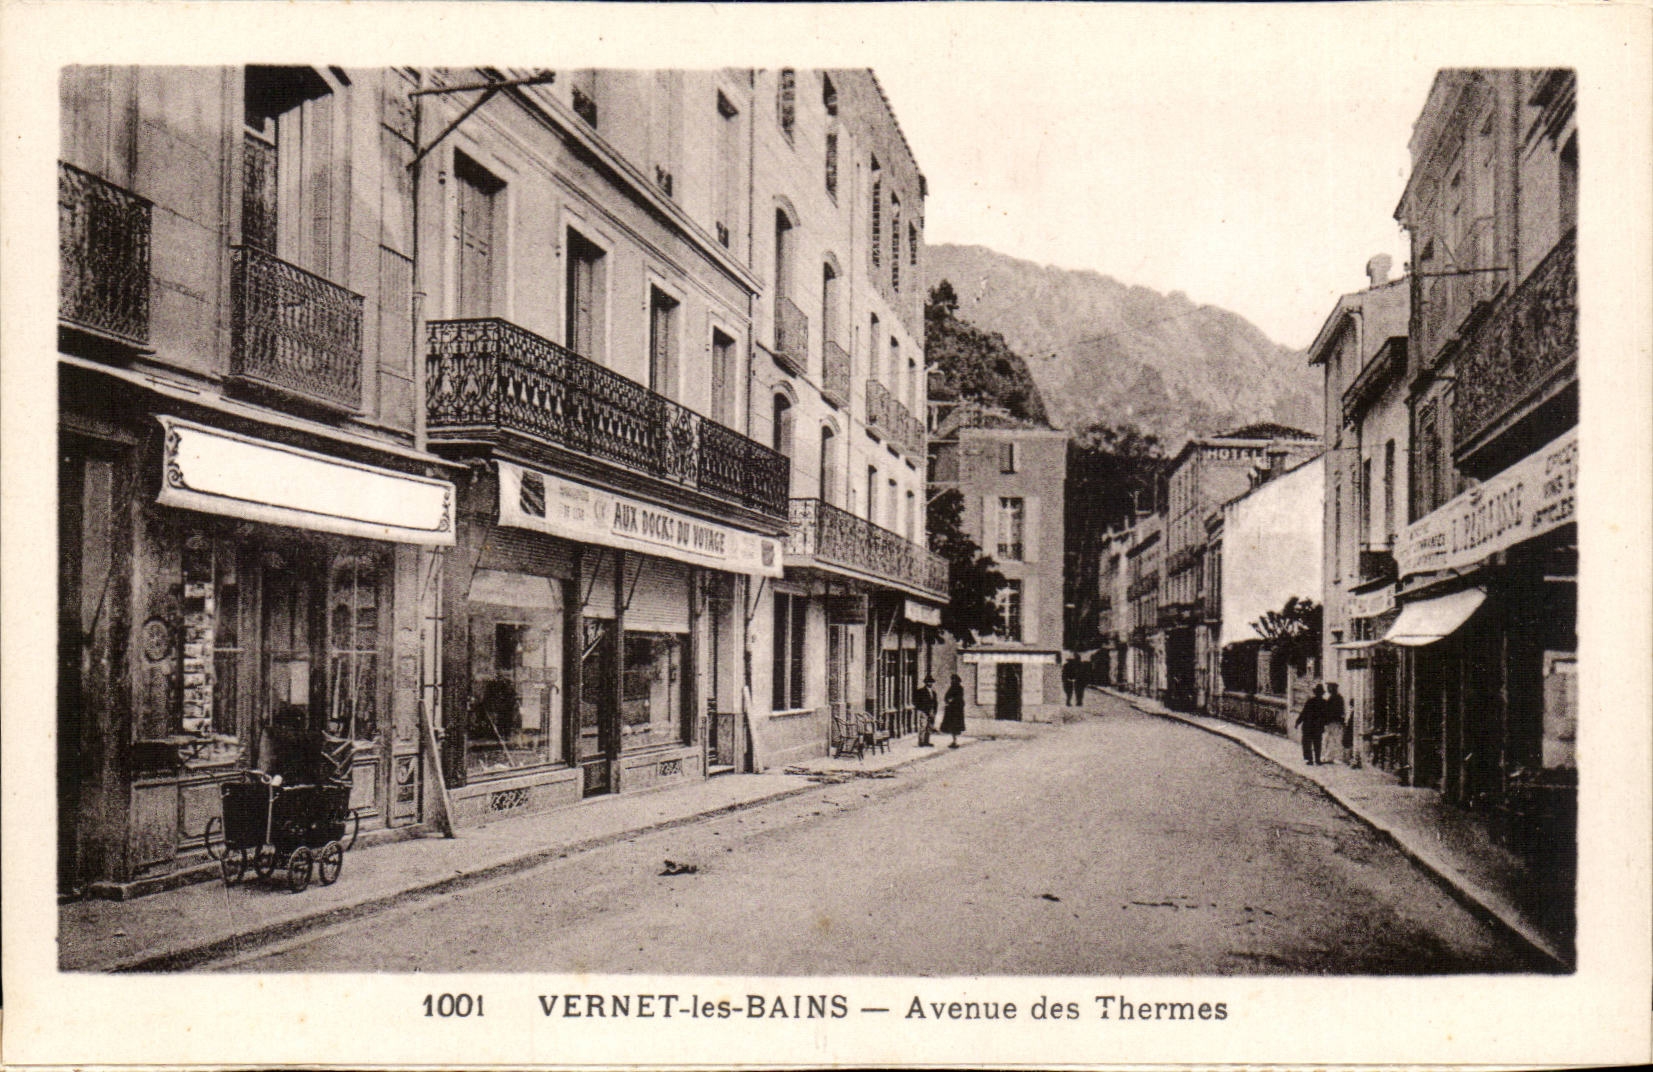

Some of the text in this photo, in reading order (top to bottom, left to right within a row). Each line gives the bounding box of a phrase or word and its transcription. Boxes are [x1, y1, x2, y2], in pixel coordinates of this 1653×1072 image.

[1207, 449, 1259, 460] HOTEL
[613, 501, 638, 533] AUX
[677, 520, 690, 545] DU
[692, 524, 726, 555] VOYAGE
